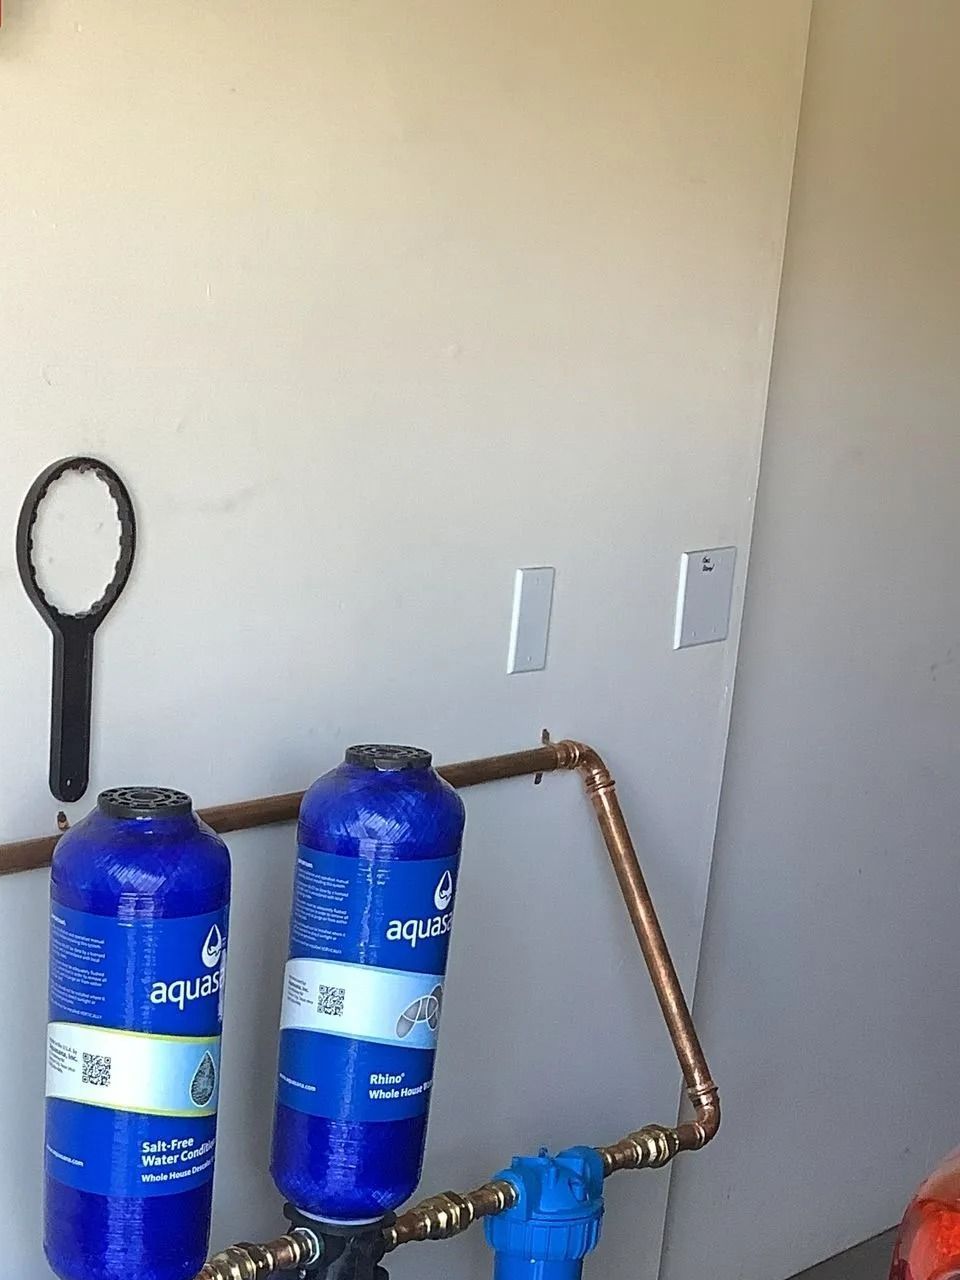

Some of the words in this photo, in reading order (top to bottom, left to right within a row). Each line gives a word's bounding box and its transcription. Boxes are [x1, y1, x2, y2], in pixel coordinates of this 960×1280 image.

[369, 1089, 400, 1099] Whole
[142, 1138, 194, 1153] Salt-Free
[142, 1154, 179, 1167] Water
[141, 1173, 168, 1182] Whole
[169, 1170, 191, 1180] House
